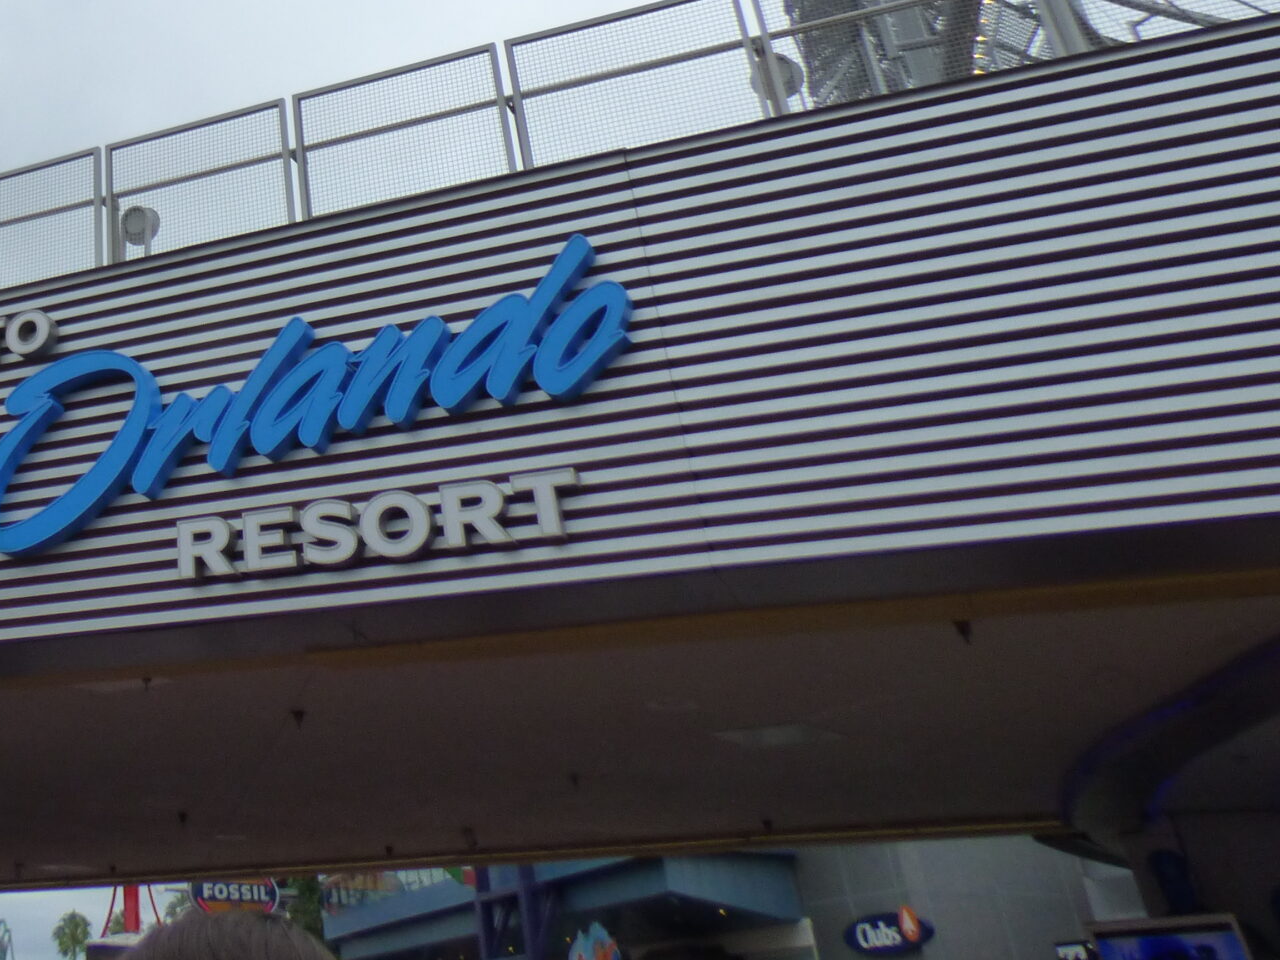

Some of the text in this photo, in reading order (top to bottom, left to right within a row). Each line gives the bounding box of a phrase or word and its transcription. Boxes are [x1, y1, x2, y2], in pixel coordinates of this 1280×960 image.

[176, 467, 580, 581] RESORT
[202, 882, 270, 902] FOSSIL
[854, 920, 902, 951] Clubs
